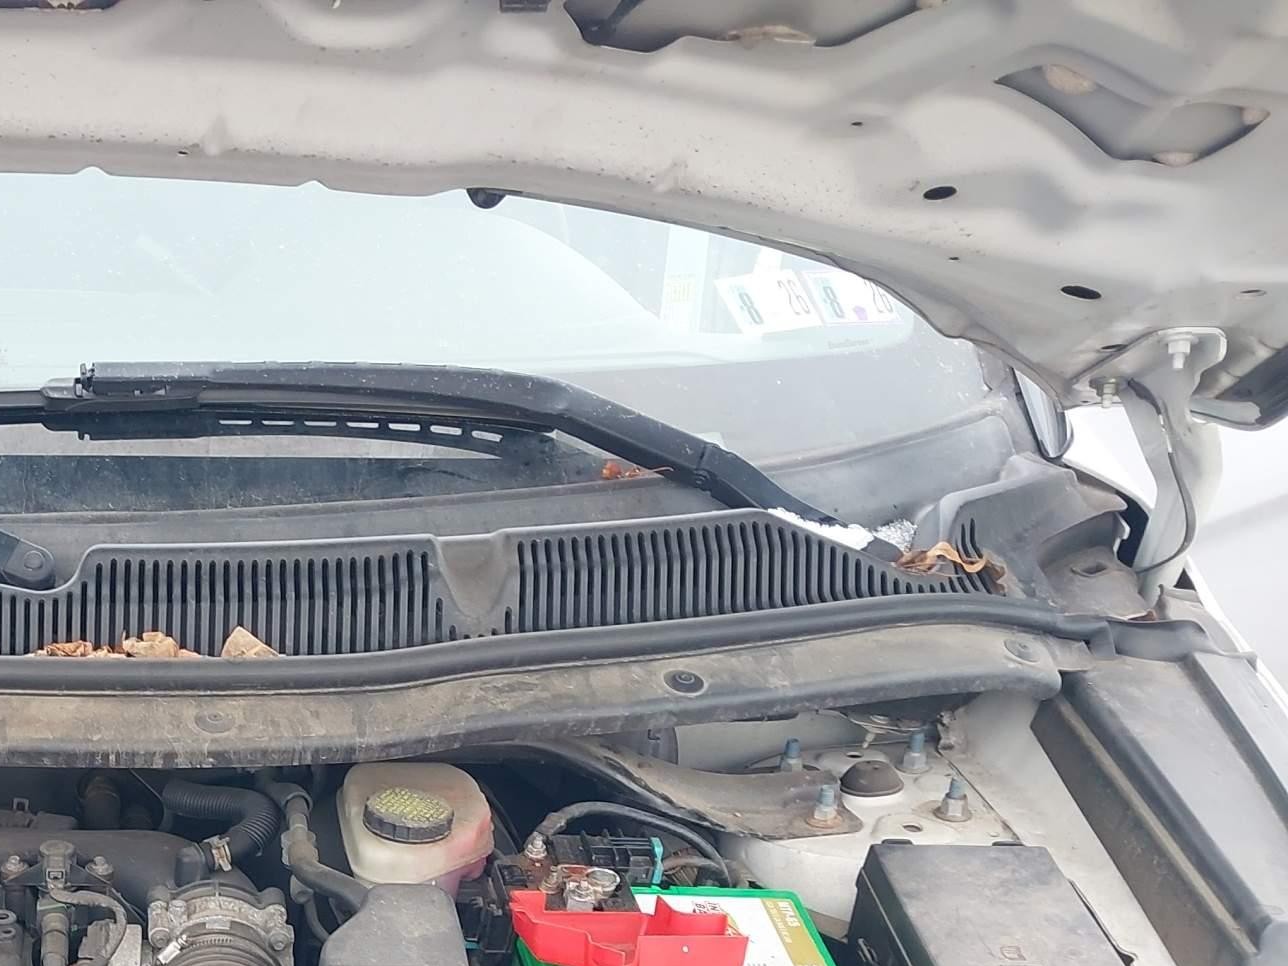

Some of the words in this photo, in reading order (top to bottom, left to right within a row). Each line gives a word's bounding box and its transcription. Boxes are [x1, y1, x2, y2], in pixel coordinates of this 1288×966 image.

[739, 292, 764, 325] 8
[777, 279, 811, 316] 26
[822, 286, 846, 319] 8
